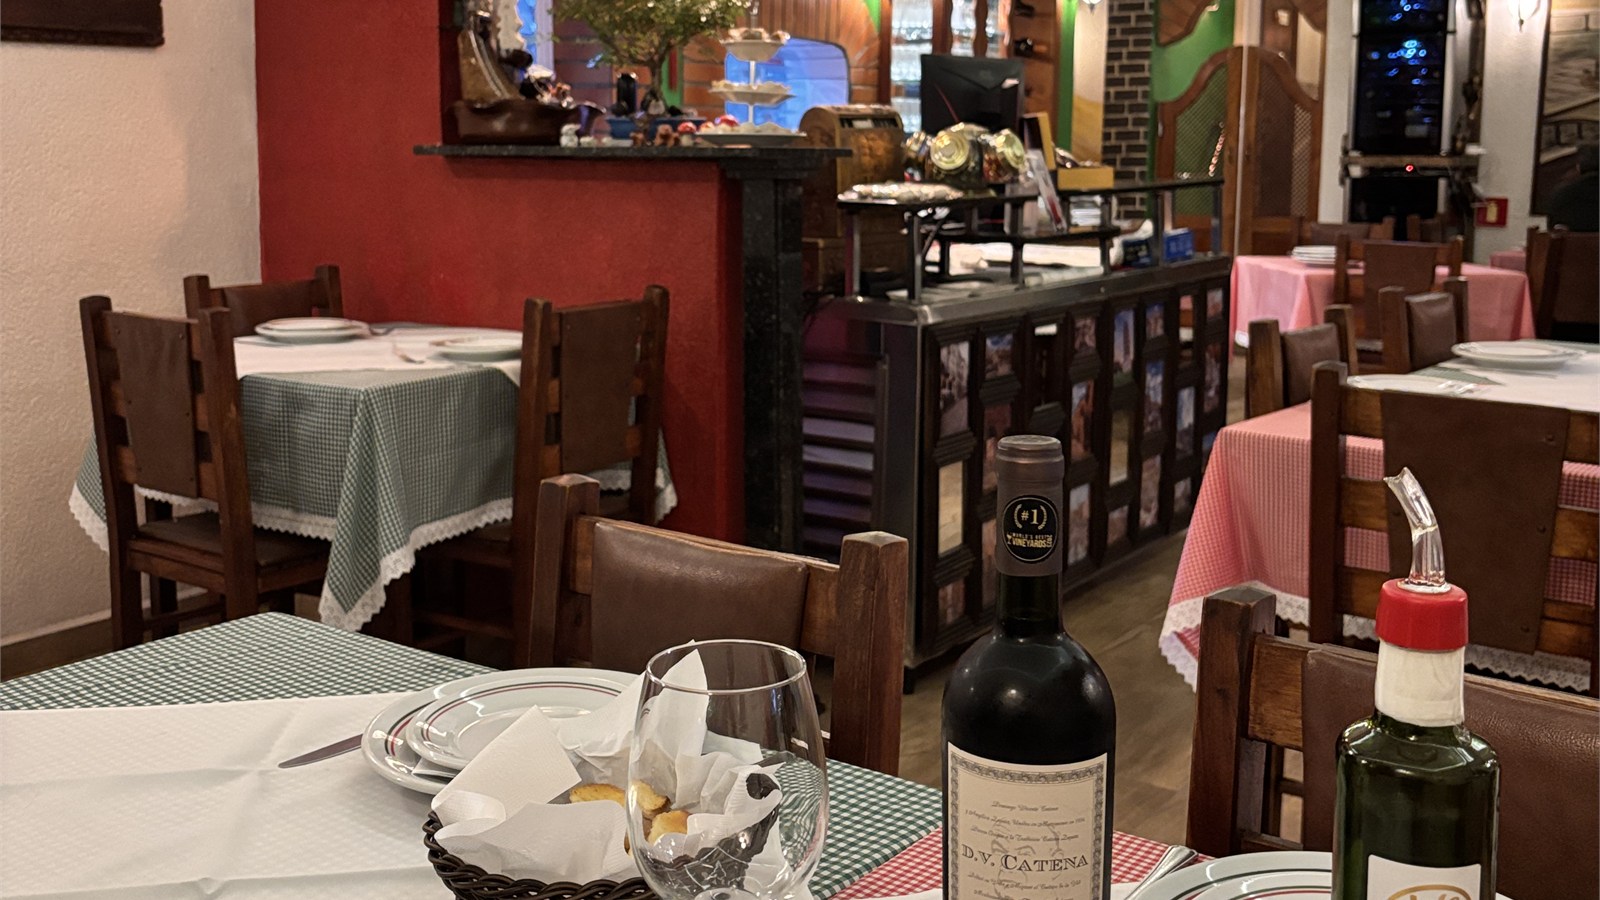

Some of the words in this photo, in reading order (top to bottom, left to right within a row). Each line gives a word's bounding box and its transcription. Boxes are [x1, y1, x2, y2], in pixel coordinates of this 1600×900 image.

[1021, 509, 1039, 525] #1
[1012, 537, 1047, 548] VINEYARDS
[961, 843, 995, 867] D.V.
[1000, 854, 1089, 872] CATENA
